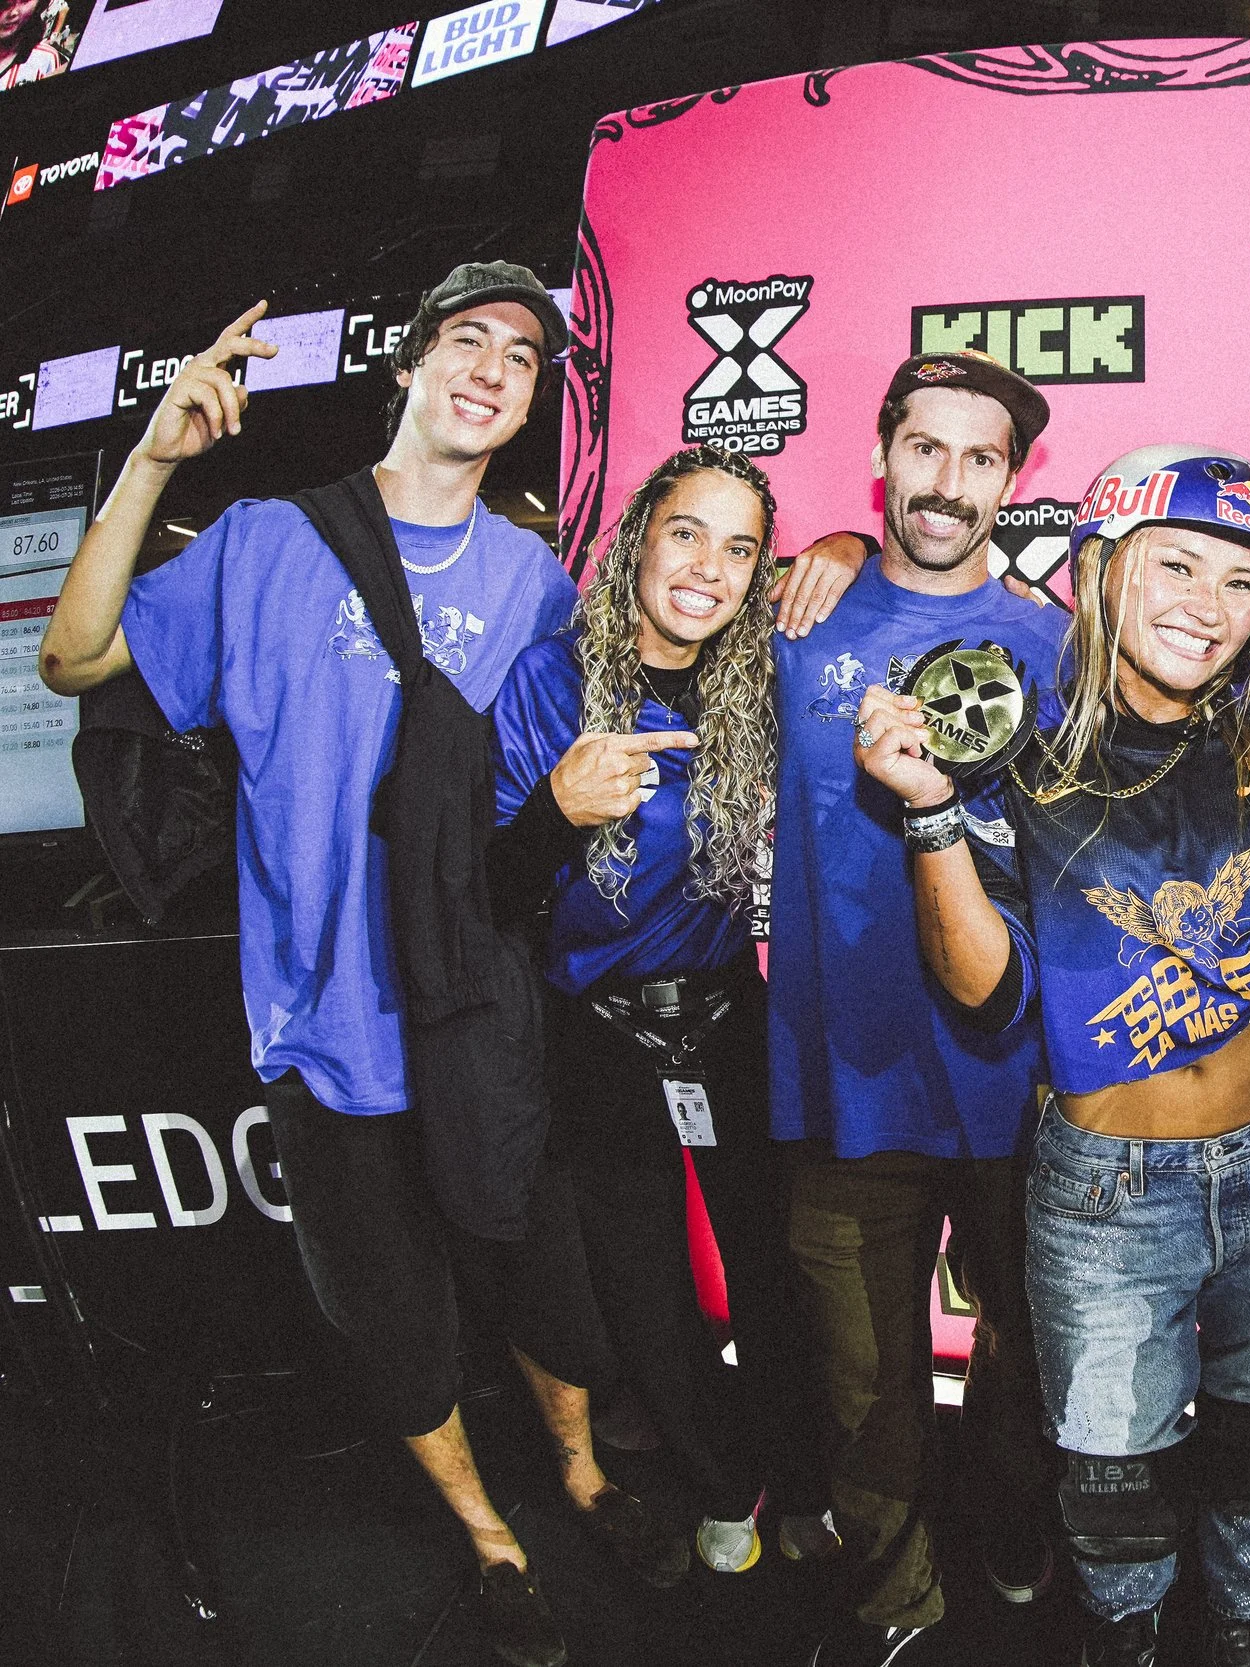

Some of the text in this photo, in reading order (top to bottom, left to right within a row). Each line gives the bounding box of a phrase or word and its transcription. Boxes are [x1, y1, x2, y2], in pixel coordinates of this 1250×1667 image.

[444, 2, 521, 43] BUD
[421, 21, 531, 75] LIGHT
[40, 152, 99, 186] TOYOTA
[715, 280, 808, 306] MoonPay
[921, 305, 1133, 376] KICK
[688, 394, 802, 425] GAMES
[687, 419, 801, 438] NEW ORLEANS
[1093, 472, 1176, 519] Bull
[995, 504, 1076, 526] oonPa
[13, 531, 59, 556] 87.60
[1085, 956, 1202, 1049] SB
[1183, 996, 1240, 1044] MÁS
[1080, 1479, 1151, 1494] KILLER PADS
[1084, 1463, 1147, 1482] 187
